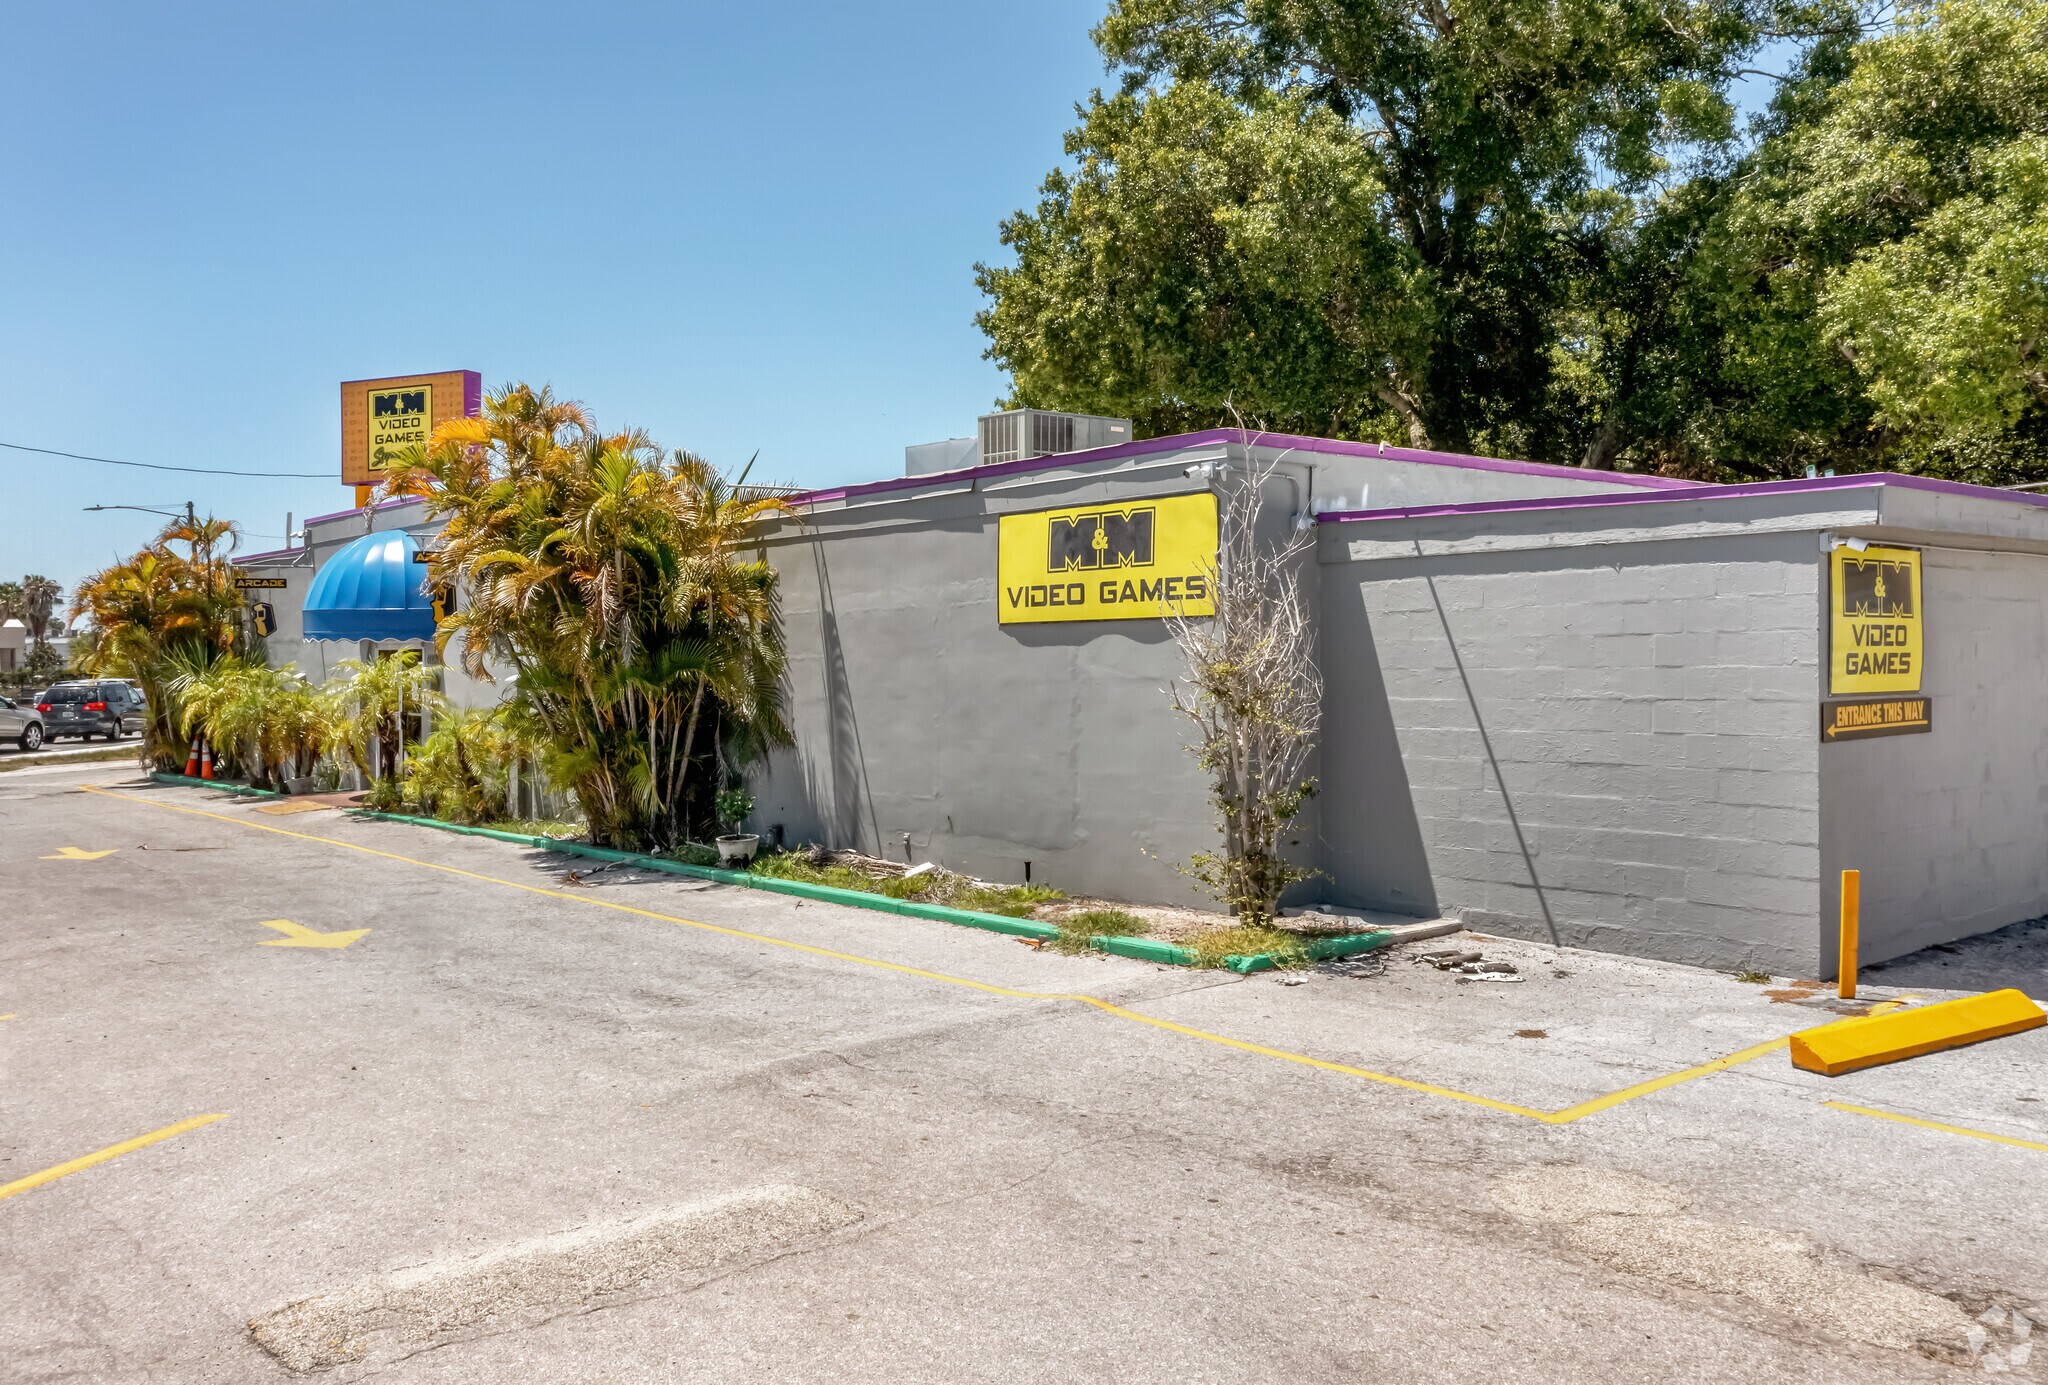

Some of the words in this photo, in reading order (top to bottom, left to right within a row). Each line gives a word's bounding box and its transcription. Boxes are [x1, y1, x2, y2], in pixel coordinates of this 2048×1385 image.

[373, 390, 426, 418] M&M
[379, 418, 420, 430] VIDEO
[375, 431, 424, 444] GAMES
[1047, 506, 1156, 573] M&M
[236, 579, 285, 587] ARCADE
[1007, 583, 1085, 608] VIDEO
[1099, 575, 1206, 604] GAMES
[1842, 558, 1914, 618] M&M
[1852, 624, 1907, 646] VIDEO
[1845, 653, 1911, 675] GAMES
[1836, 703, 1882, 727] ENTRANCE
[1883, 702, 1903, 722] THIS
[1904, 700, 1924, 720] WAY
